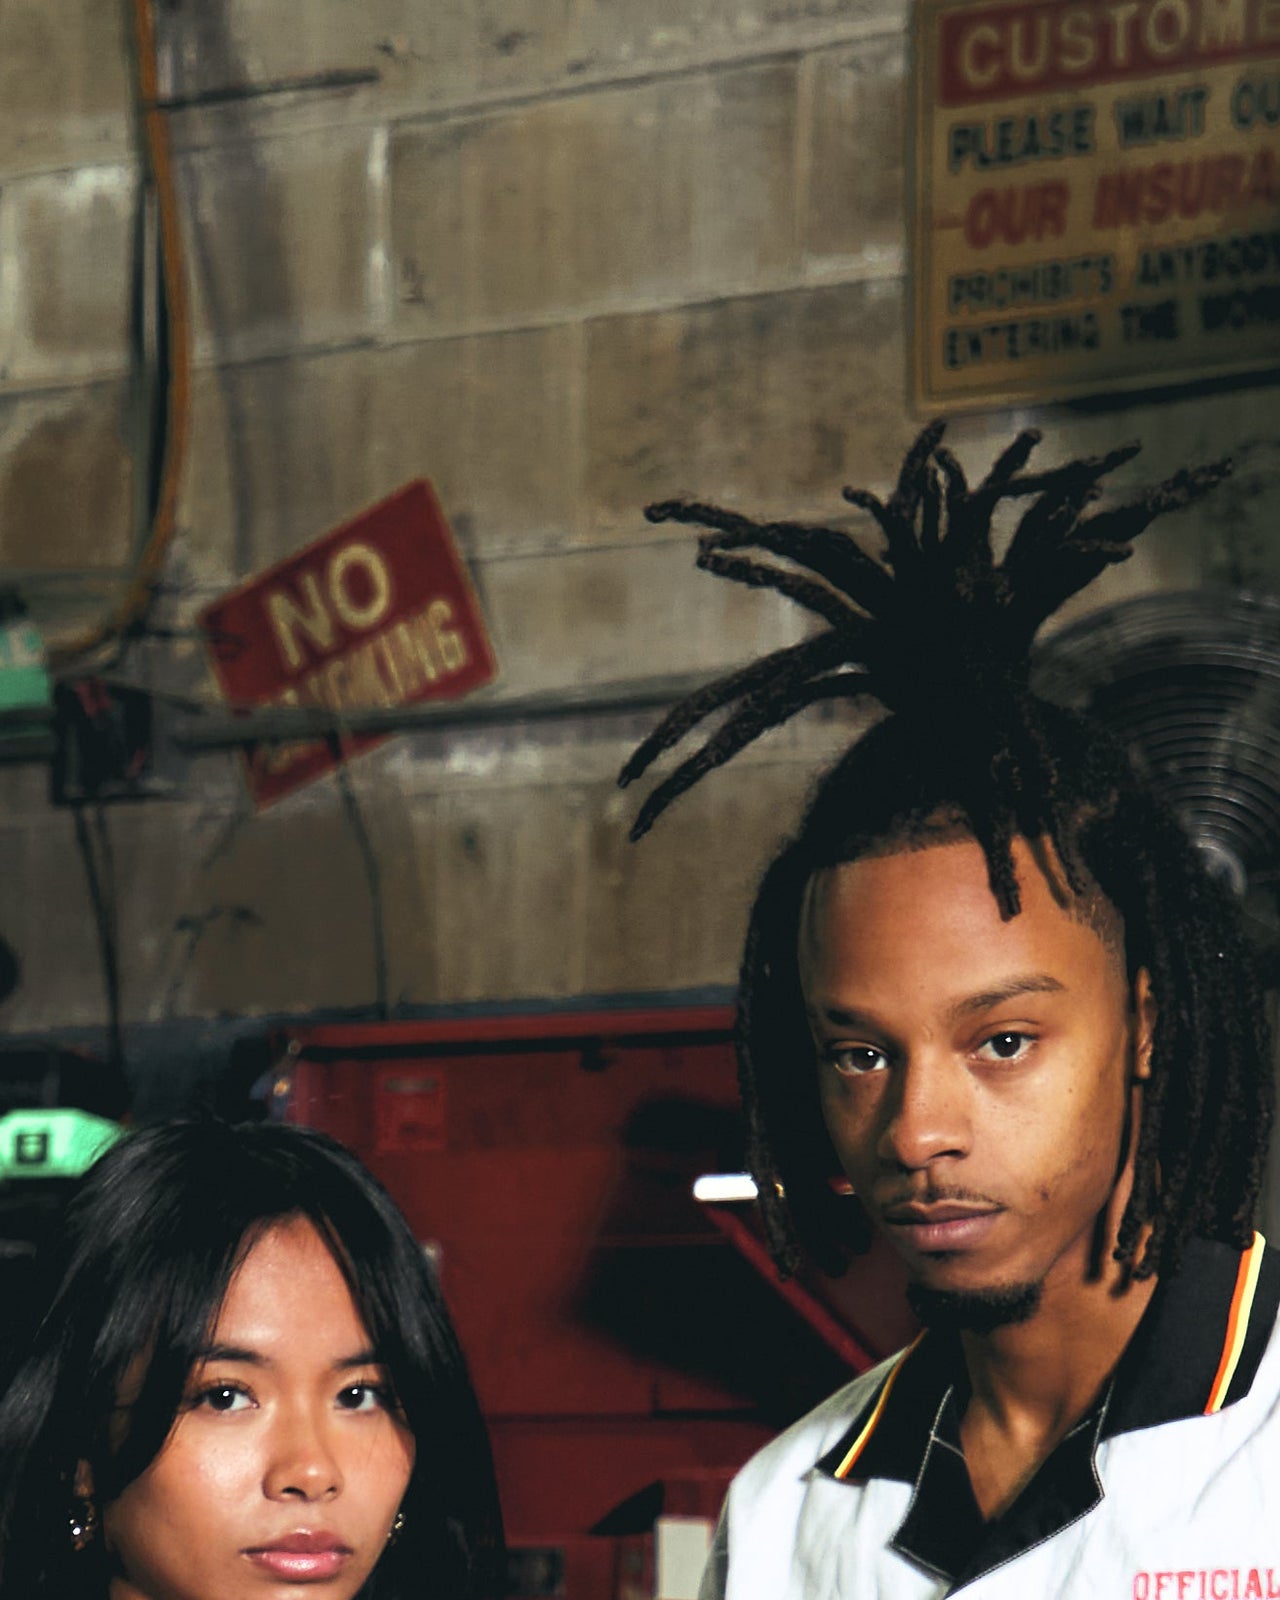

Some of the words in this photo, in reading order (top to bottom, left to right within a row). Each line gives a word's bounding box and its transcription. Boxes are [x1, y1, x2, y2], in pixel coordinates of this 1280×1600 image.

[949, 106, 1094, 174] PLEASE
[1116, 86, 1208, 146] WAIT
[965, 178, 1070, 250] OUR
[266, 544, 392, 672] NO
